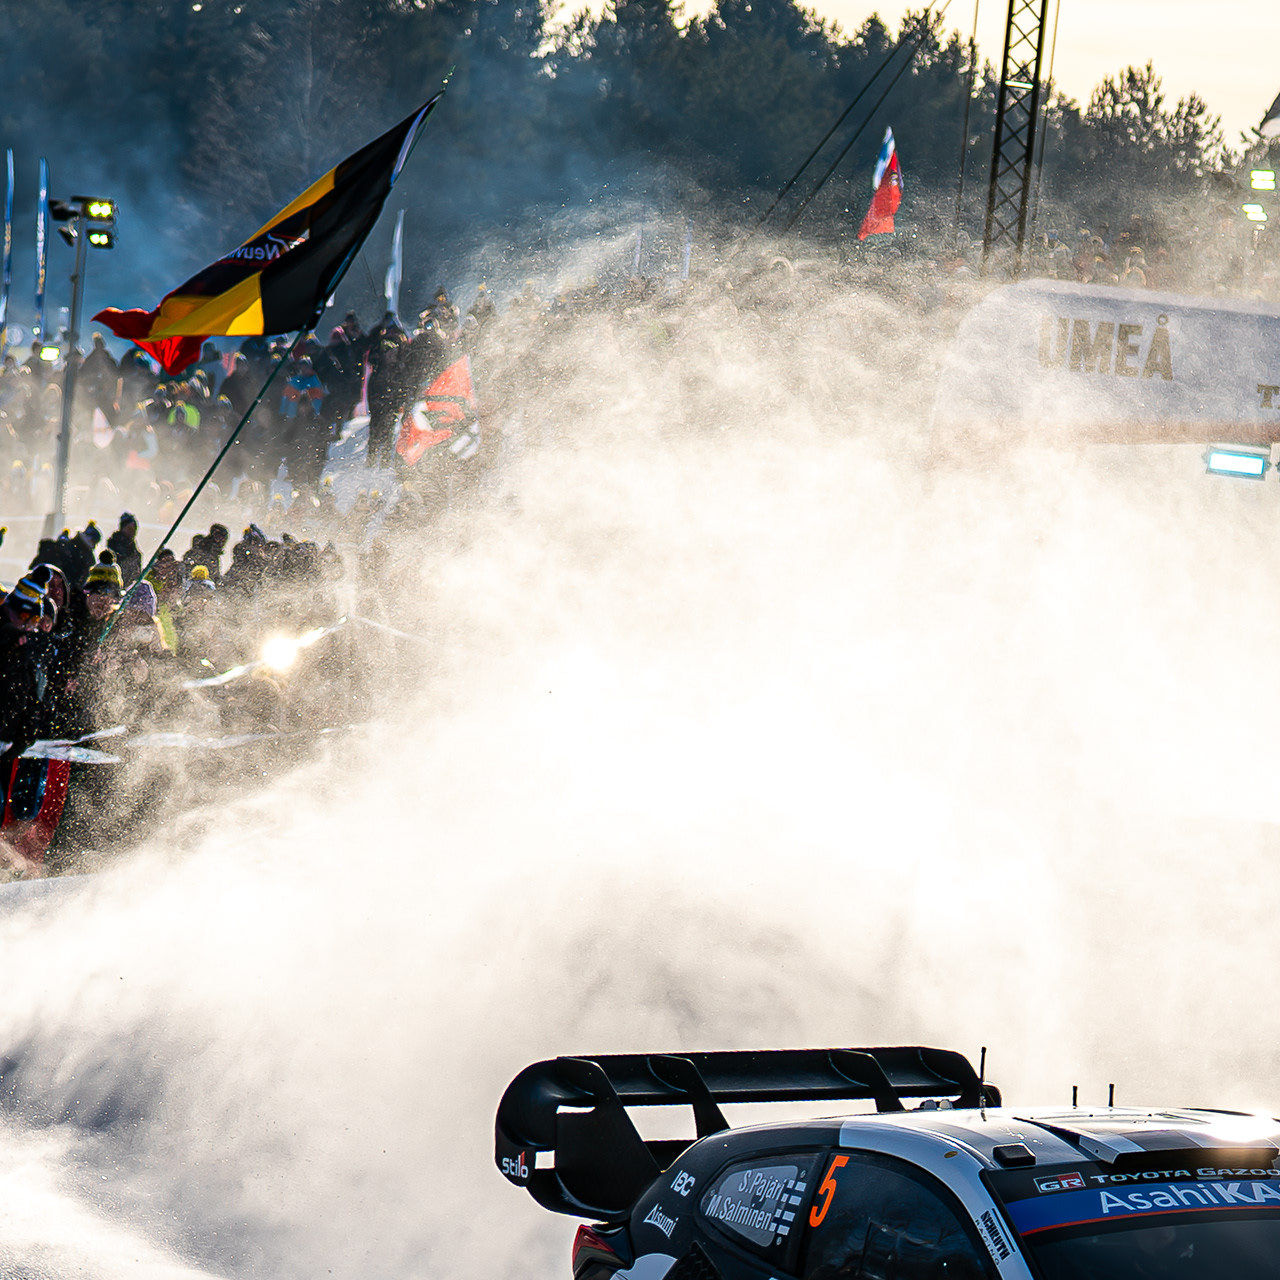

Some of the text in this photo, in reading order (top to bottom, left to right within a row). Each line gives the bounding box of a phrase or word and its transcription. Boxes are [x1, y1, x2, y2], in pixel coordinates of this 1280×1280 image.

[502, 1151, 529, 1179] Stilo
[1039, 1177, 1082, 1191] GR
[1090, 1169, 1192, 1184] TOYOTA
[738, 1170, 787, 1202] S.Pajari
[809, 1154, 850, 1228] 5
[705, 1194, 773, 1231] M.Salminen
